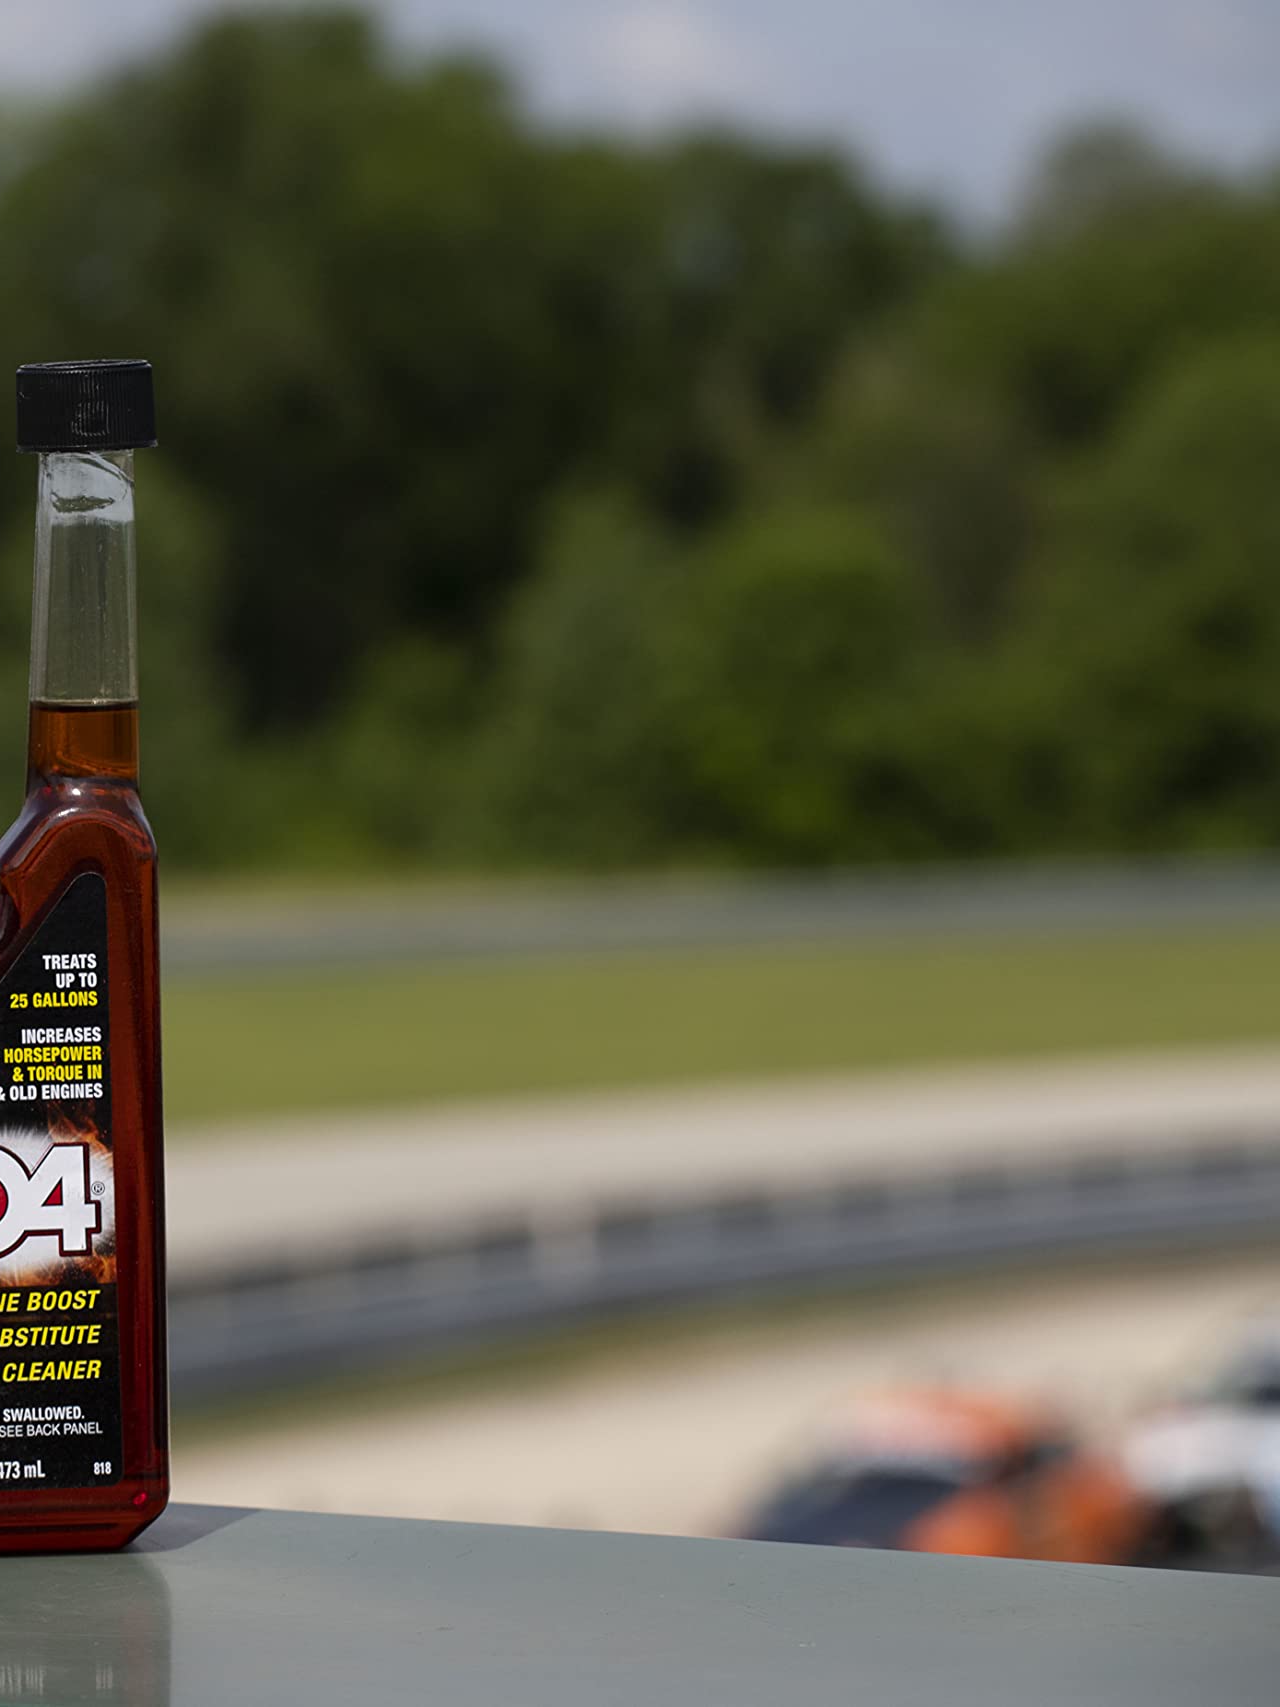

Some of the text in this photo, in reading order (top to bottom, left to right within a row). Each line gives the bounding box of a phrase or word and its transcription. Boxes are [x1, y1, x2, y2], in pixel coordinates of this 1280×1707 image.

[42, 953, 97, 970] TREATS
[56, 973, 97, 989] UP TO
[10, 991, 98, 1009] 25 GALLONS
[21, 1027, 102, 1043] INCREASES
[4, 1046, 102, 1063] HORSEPOWER
[12, 1065, 102, 1082] & TORQUE IN
[9, 1086, 37, 1101] OLD
[41, 1084, 103, 1100] ENGINES
[26, 1289, 100, 1311] BOOST
[1, 1359, 102, 1383] CLEANER
[3, 1406, 85, 1423] SWALLOWED.
[26, 1423, 61, 1437] BACK
[63, 1422, 103, 1435] PANEL
[24, 1460, 46, 1478] mL
[93, 1462, 112, 1476] 818
